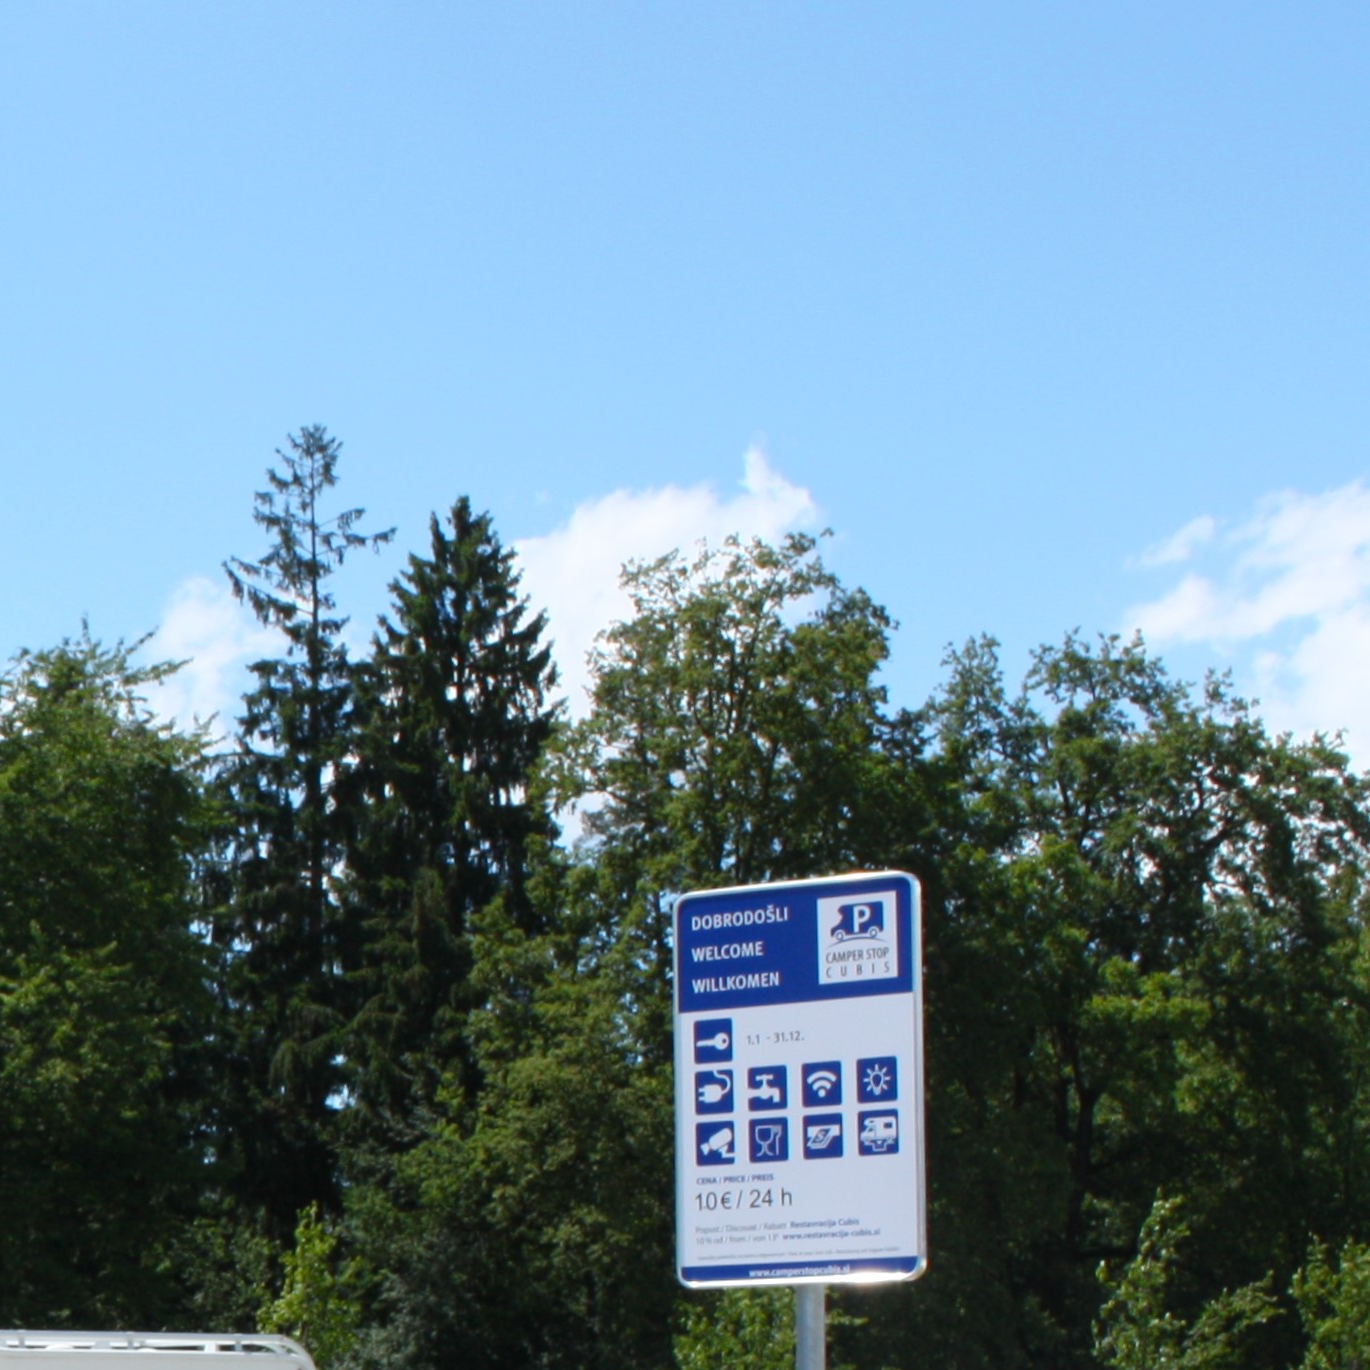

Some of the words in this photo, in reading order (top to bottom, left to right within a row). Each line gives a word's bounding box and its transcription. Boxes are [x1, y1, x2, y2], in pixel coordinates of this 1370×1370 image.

[691, 904, 789, 931] DOBRODOŠLI
[852, 905, 871, 933] P
[691, 941, 764, 962] WELCOME
[825, 949, 864, 964] CAMPER
[866, 946, 890, 961] STOP
[692, 972, 780, 994] WILLKOMEN
[773, 1030, 805, 1044] 31.12.
[696, 1177, 717, 1185] CENA
[723, 1175, 746, 1184] PRICE
[751, 1173, 774, 1182] PREIS
[749, 1187, 773, 1208] 24
[781, 1186, 792, 1206] h
